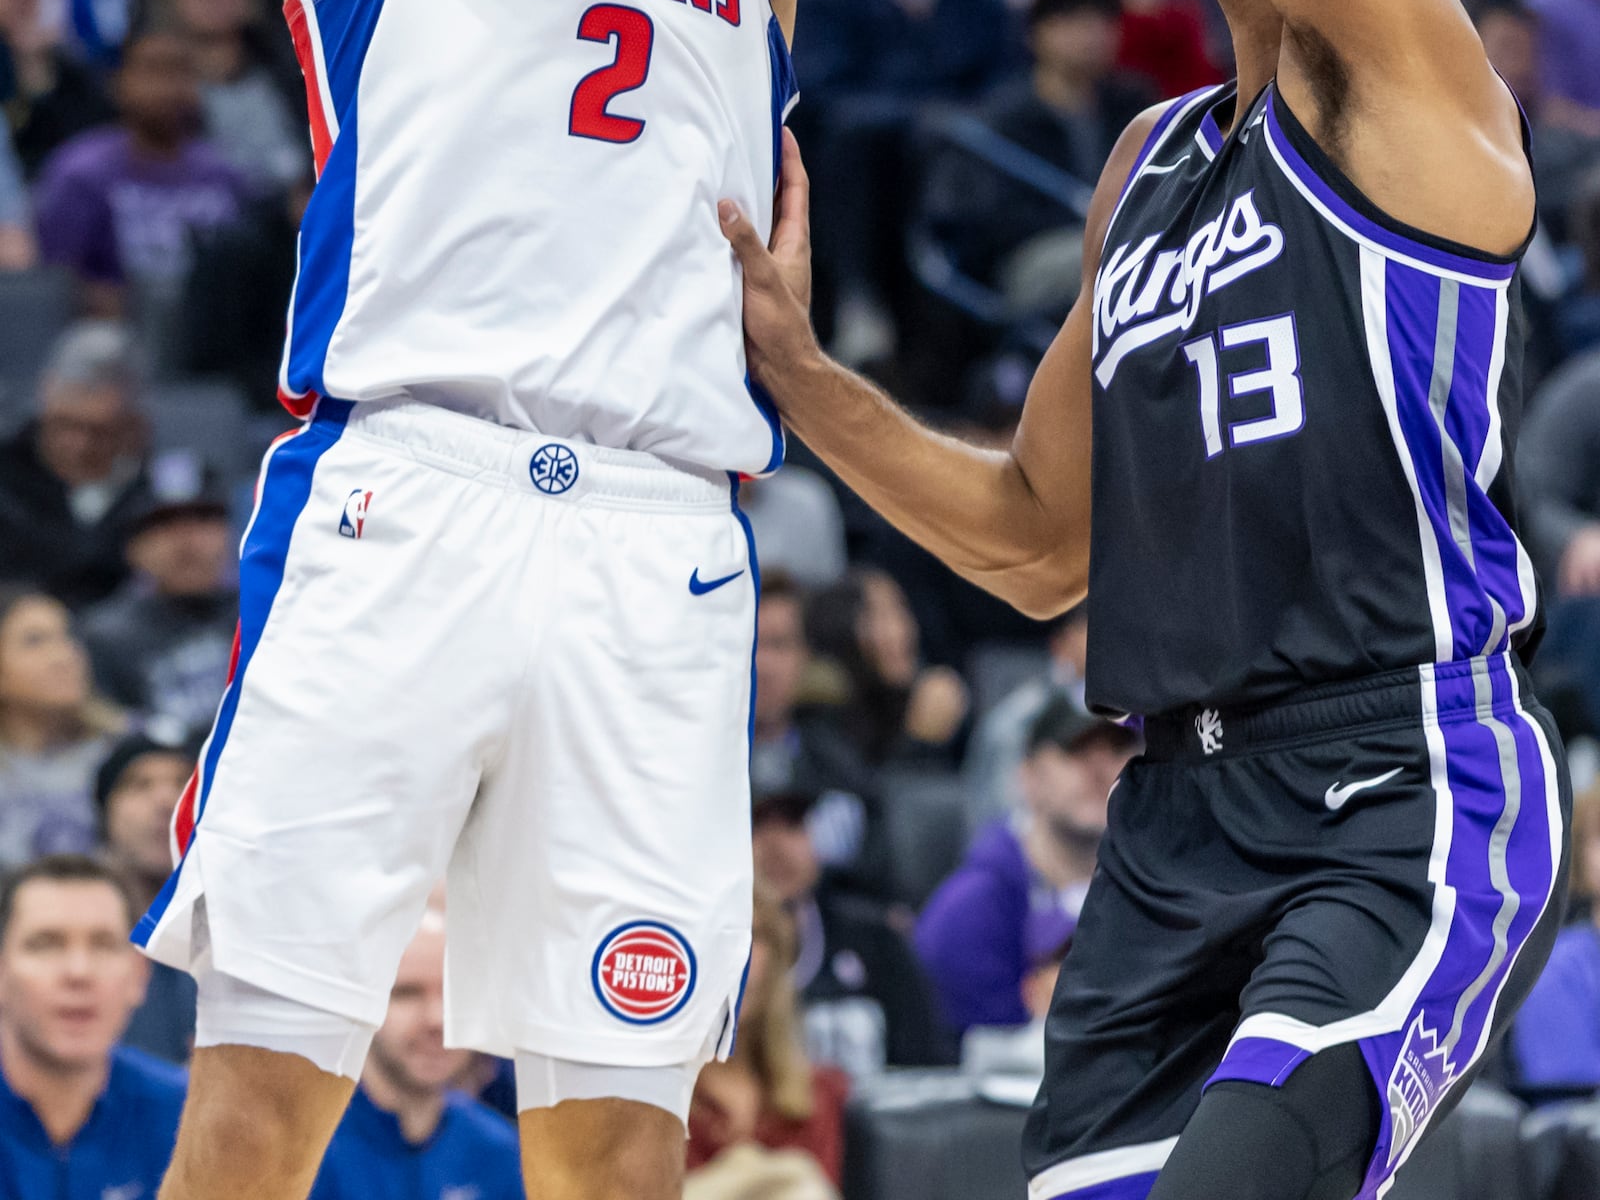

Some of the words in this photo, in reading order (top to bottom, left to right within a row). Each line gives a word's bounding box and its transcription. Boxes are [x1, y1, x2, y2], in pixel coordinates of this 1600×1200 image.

[568, 2, 655, 144] 2
[1092, 187, 1286, 392] Kings
[1177, 310, 1306, 461] 13
[612, 970, 675, 992] PISTONS
[615, 953, 677, 974] DETROIT
